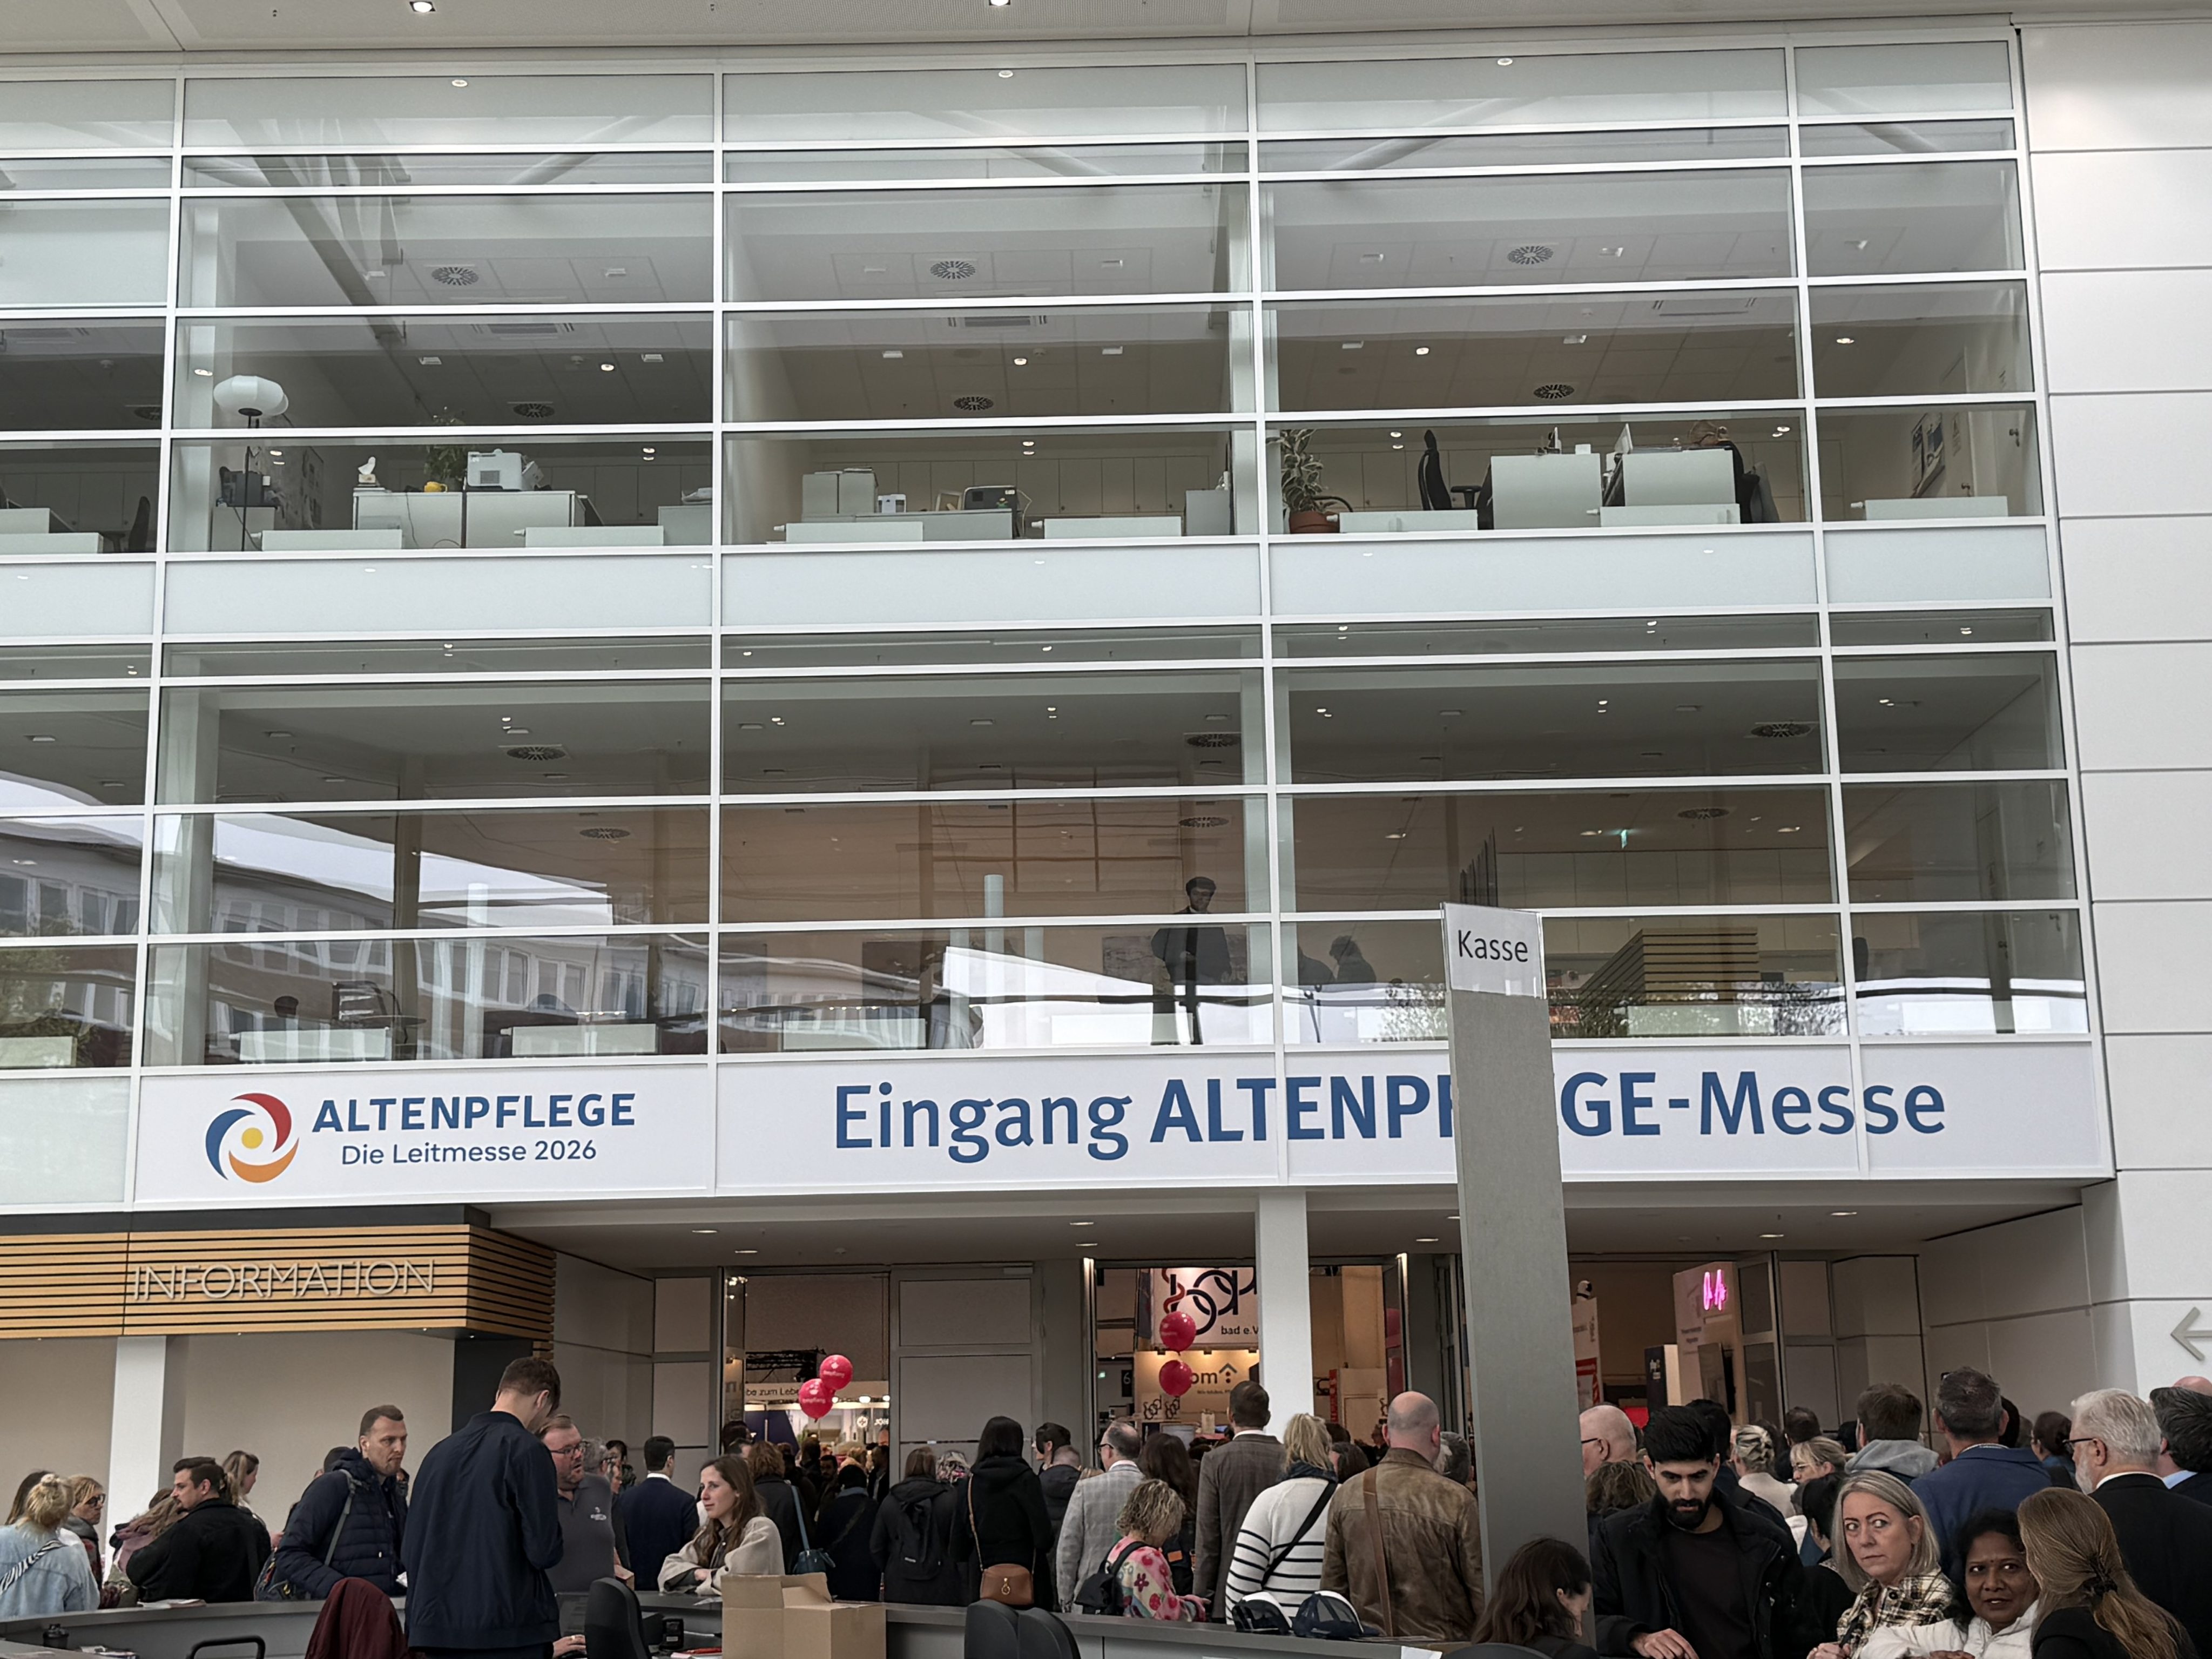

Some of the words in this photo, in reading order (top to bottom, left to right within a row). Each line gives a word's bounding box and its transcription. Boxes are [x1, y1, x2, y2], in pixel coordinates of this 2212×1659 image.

[1458, 929, 1528, 962] Kasse
[312, 1093, 636, 1132] ALTENPFLEGE
[835, 1082, 1132, 1163] Eingang
[1150, 1071, 1945, 1143] ALTENPGE-Messe
[342, 1144, 384, 1165] Die
[393, 1142, 527, 1163] Leitmesse
[534, 1139, 597, 1160] 2026
[134, 1260, 434, 1300] INFORMATION
[1221, 1325, 1240, 1335] bad
[1123, 1372, 1131, 1384] 6
